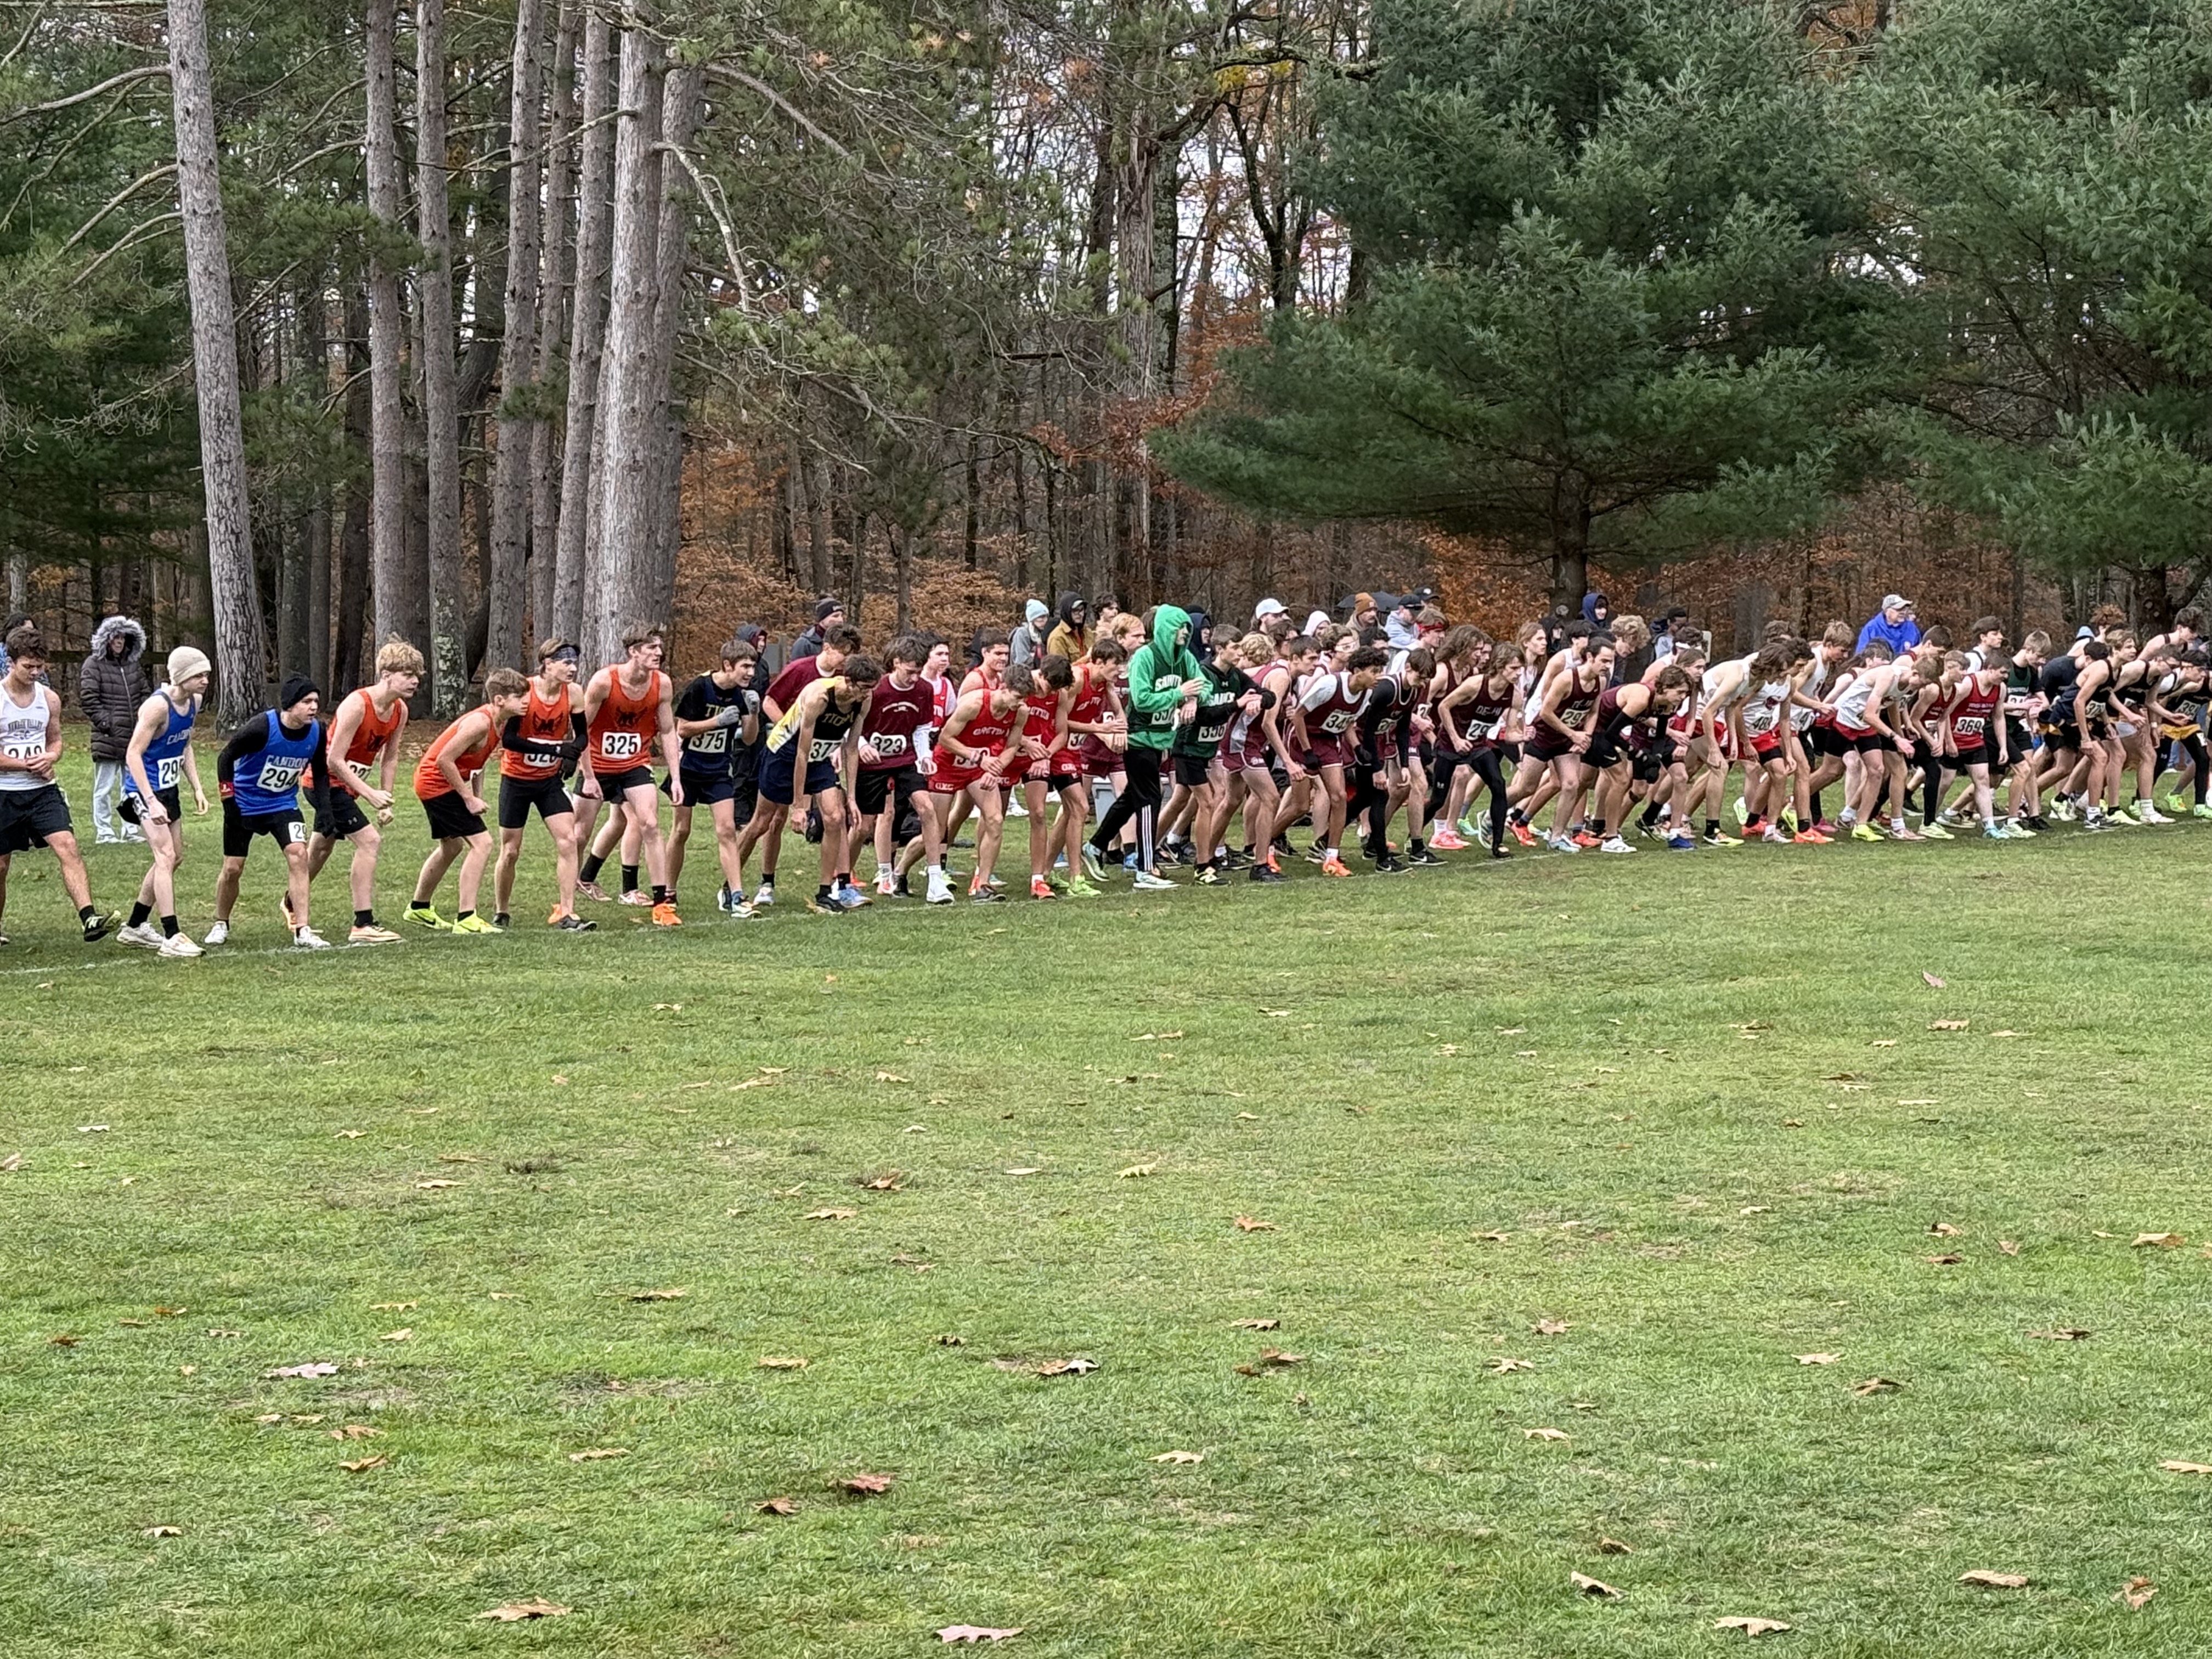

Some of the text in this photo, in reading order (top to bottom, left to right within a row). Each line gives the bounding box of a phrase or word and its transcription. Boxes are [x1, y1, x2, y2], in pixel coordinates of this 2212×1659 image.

[1957, 719, 1983, 733] 369
[605, 735, 637, 755] 325
[692, 732, 725, 750] 375
[873, 736, 903, 754] 323
[261, 768, 301, 788] 294
